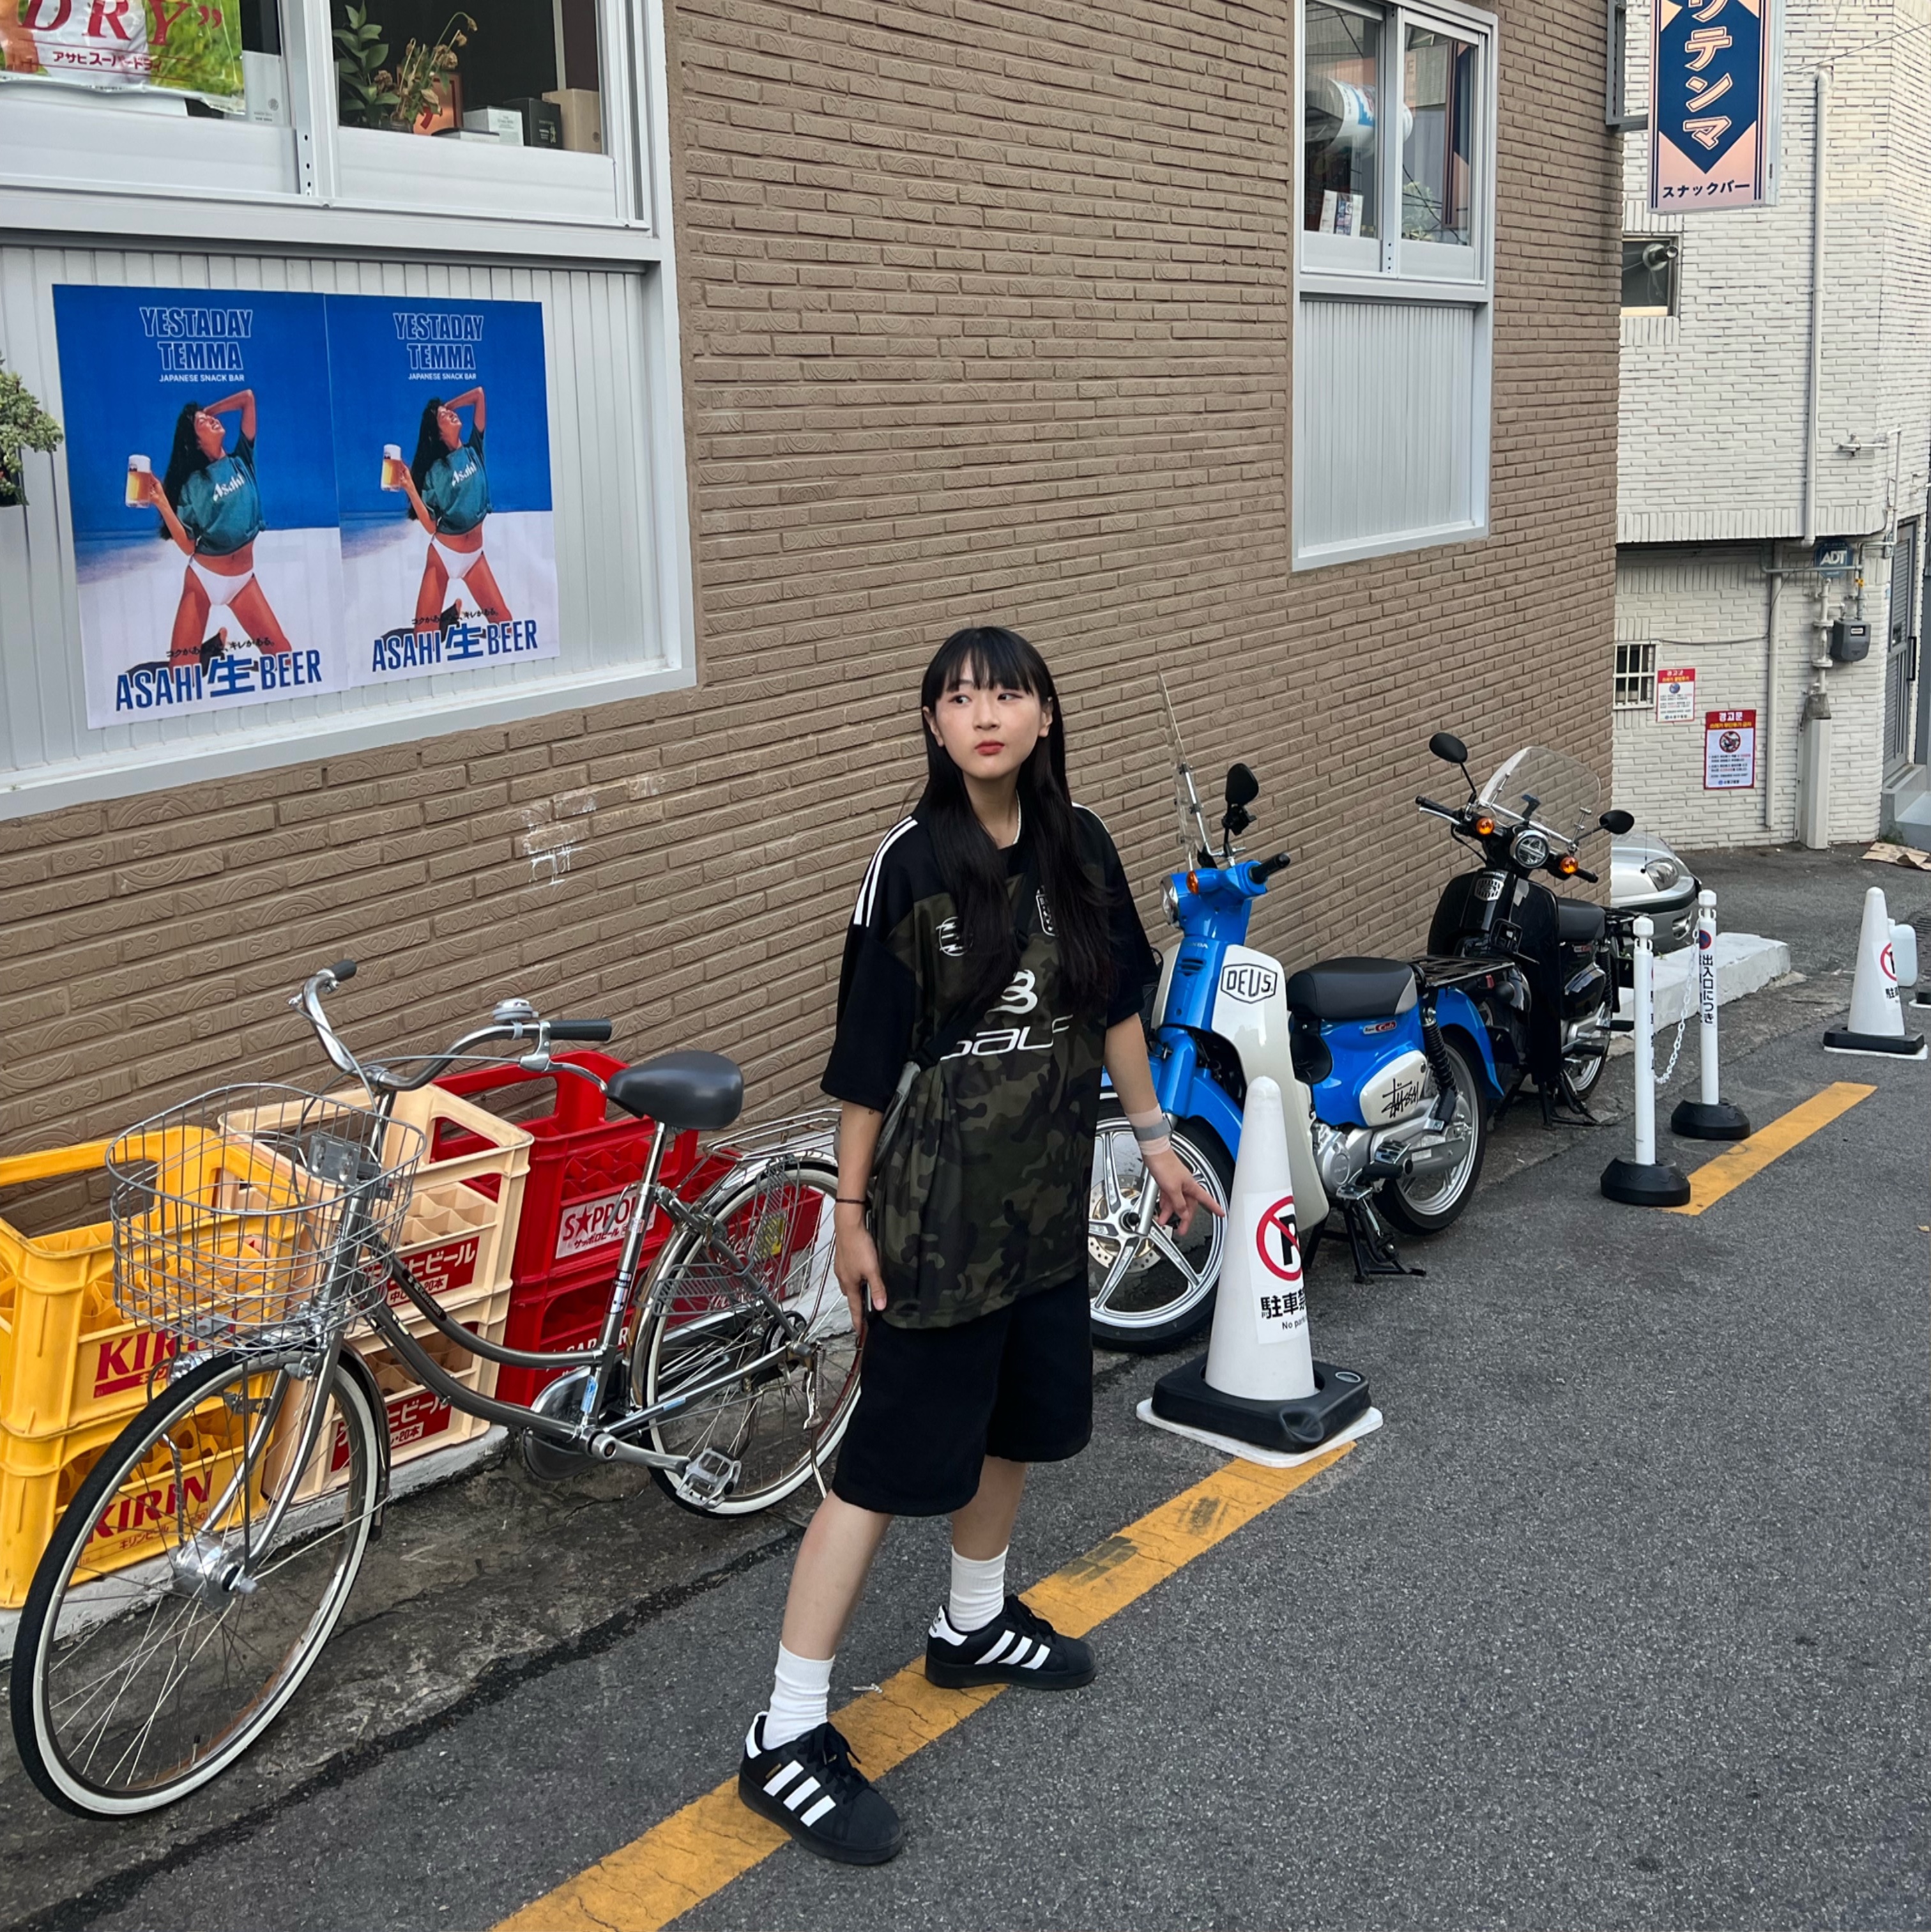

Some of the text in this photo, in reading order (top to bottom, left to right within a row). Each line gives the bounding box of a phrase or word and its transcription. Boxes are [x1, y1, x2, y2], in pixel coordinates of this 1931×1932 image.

[1662, 179, 1750, 198] スナックバー
[139, 306, 253, 339] YESTADAY
[393, 312, 484, 341] YESTADAY
[156, 341, 244, 371] TEMMA
[406, 343, 477, 370] TEMMA
[213, 473, 246, 502] Asahi
[452, 461, 478, 487] Asahi
[1819, 551, 1847, 565] ADT
[372, 620, 538, 672] ASAHI 生 BEER
[116, 649, 323, 711] ASAHI 生 BEER
[1226, 968, 1272, 997] DEUS
[1702, 954, 1714, 1024] 出入口につき
[1282, 1321, 1294, 1330] No
